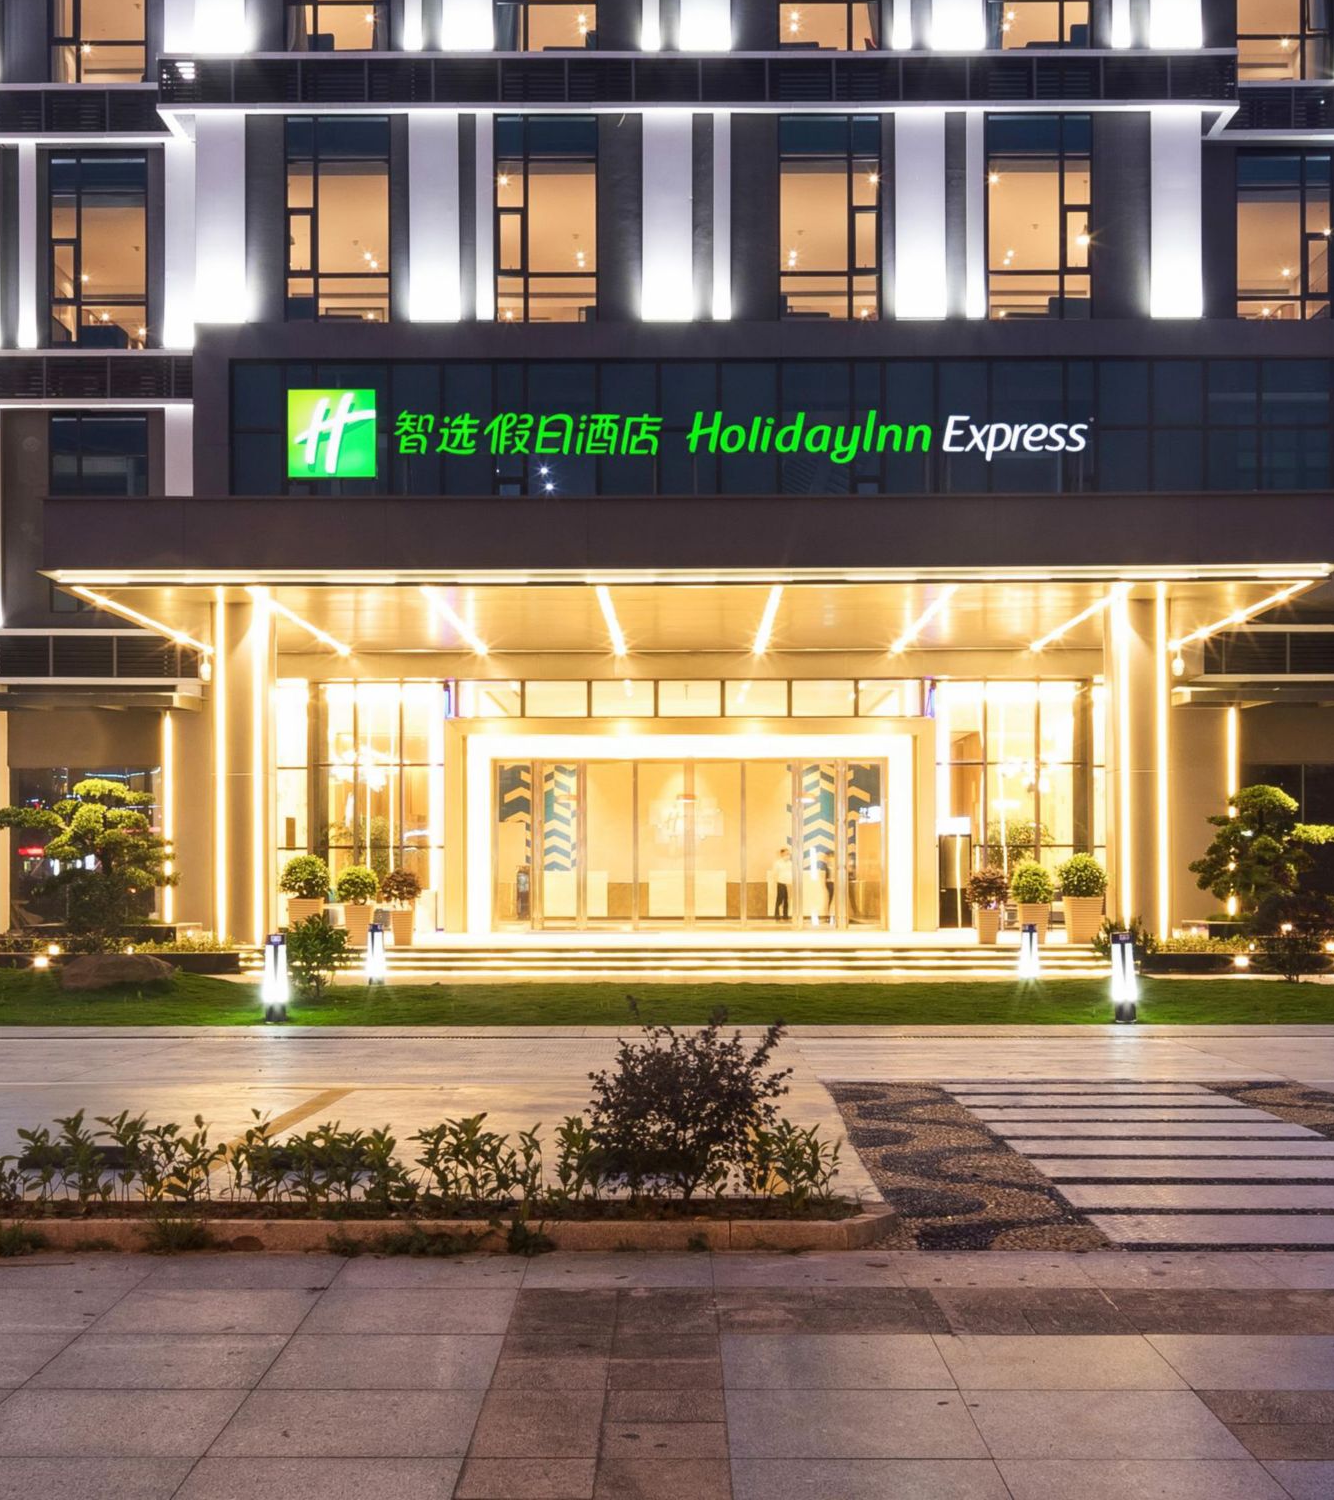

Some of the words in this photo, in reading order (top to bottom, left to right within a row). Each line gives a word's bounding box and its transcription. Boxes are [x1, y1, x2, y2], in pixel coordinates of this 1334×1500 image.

[393, 409, 664, 455] 智选假日酒店
[942, 415, 1088, 462] Express
